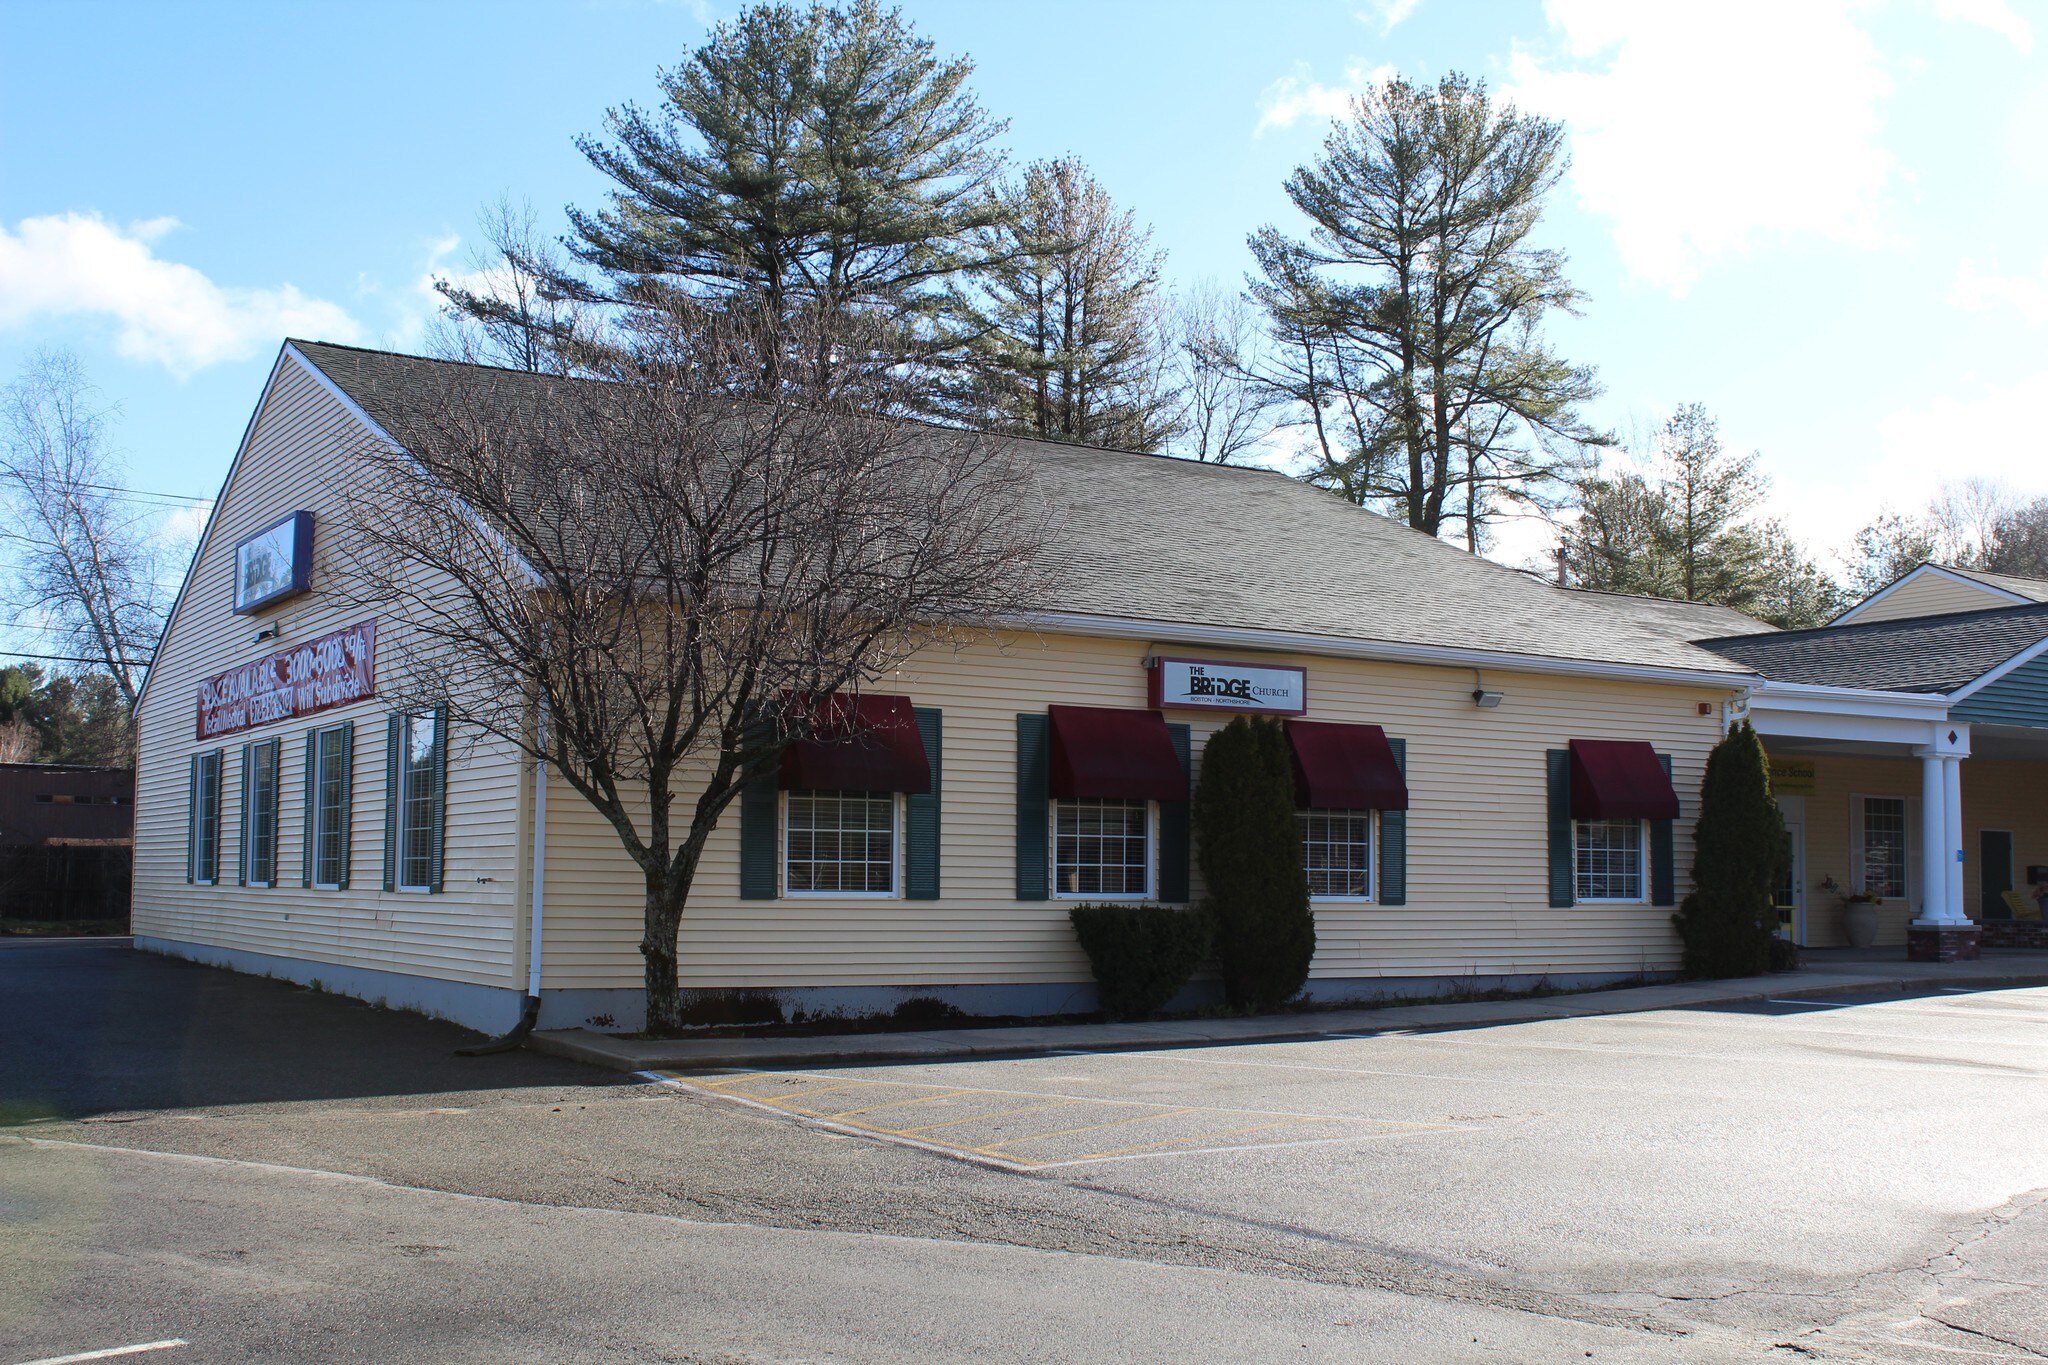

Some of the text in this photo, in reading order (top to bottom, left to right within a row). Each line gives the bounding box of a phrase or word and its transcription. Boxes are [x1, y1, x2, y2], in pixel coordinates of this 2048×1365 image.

[1189, 666, 1205, 676] THE
[1252, 686, 1289, 697] CHURCH
[1788, 767, 1815, 777] School
